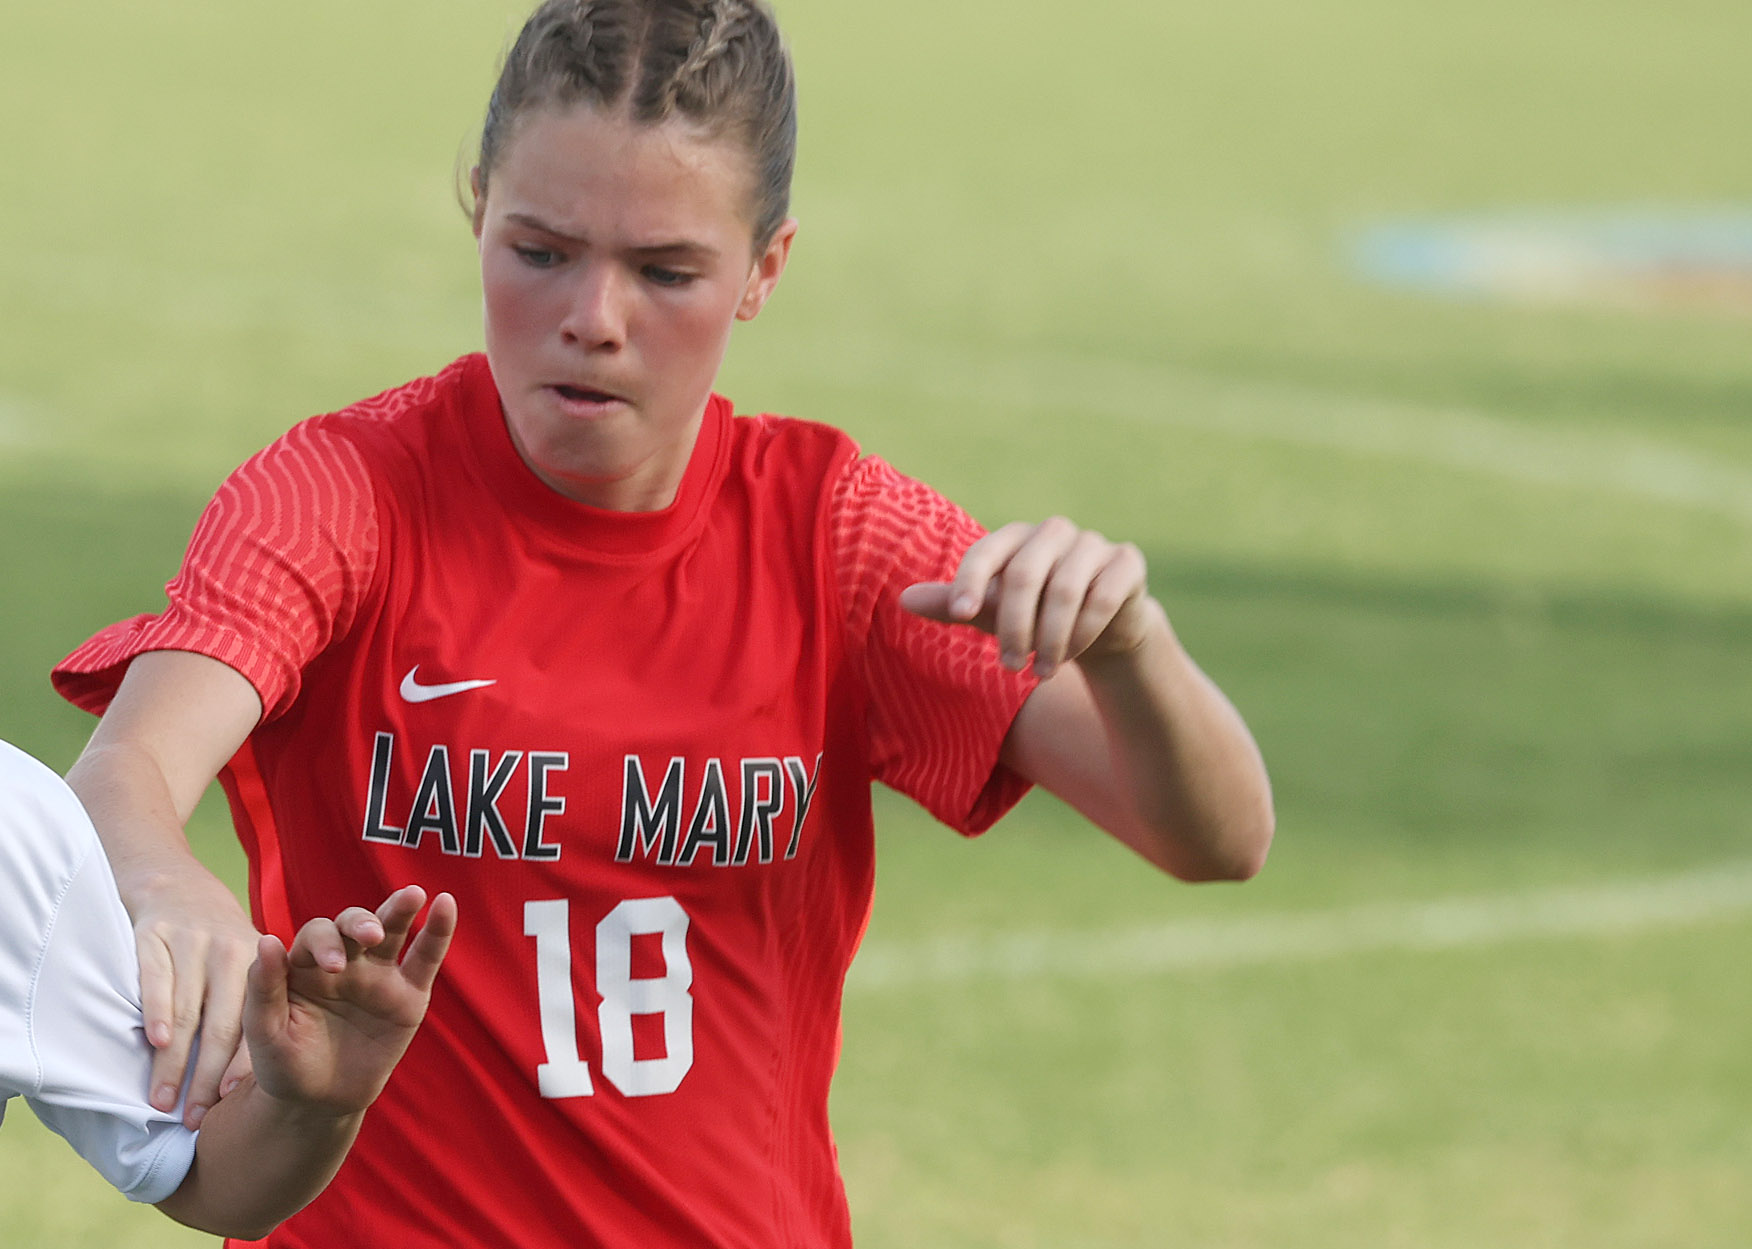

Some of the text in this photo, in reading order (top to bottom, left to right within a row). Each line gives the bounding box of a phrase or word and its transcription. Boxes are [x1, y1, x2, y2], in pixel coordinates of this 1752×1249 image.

[361, 731, 823, 867] LAKE MARY
[524, 896, 694, 1098] 18
